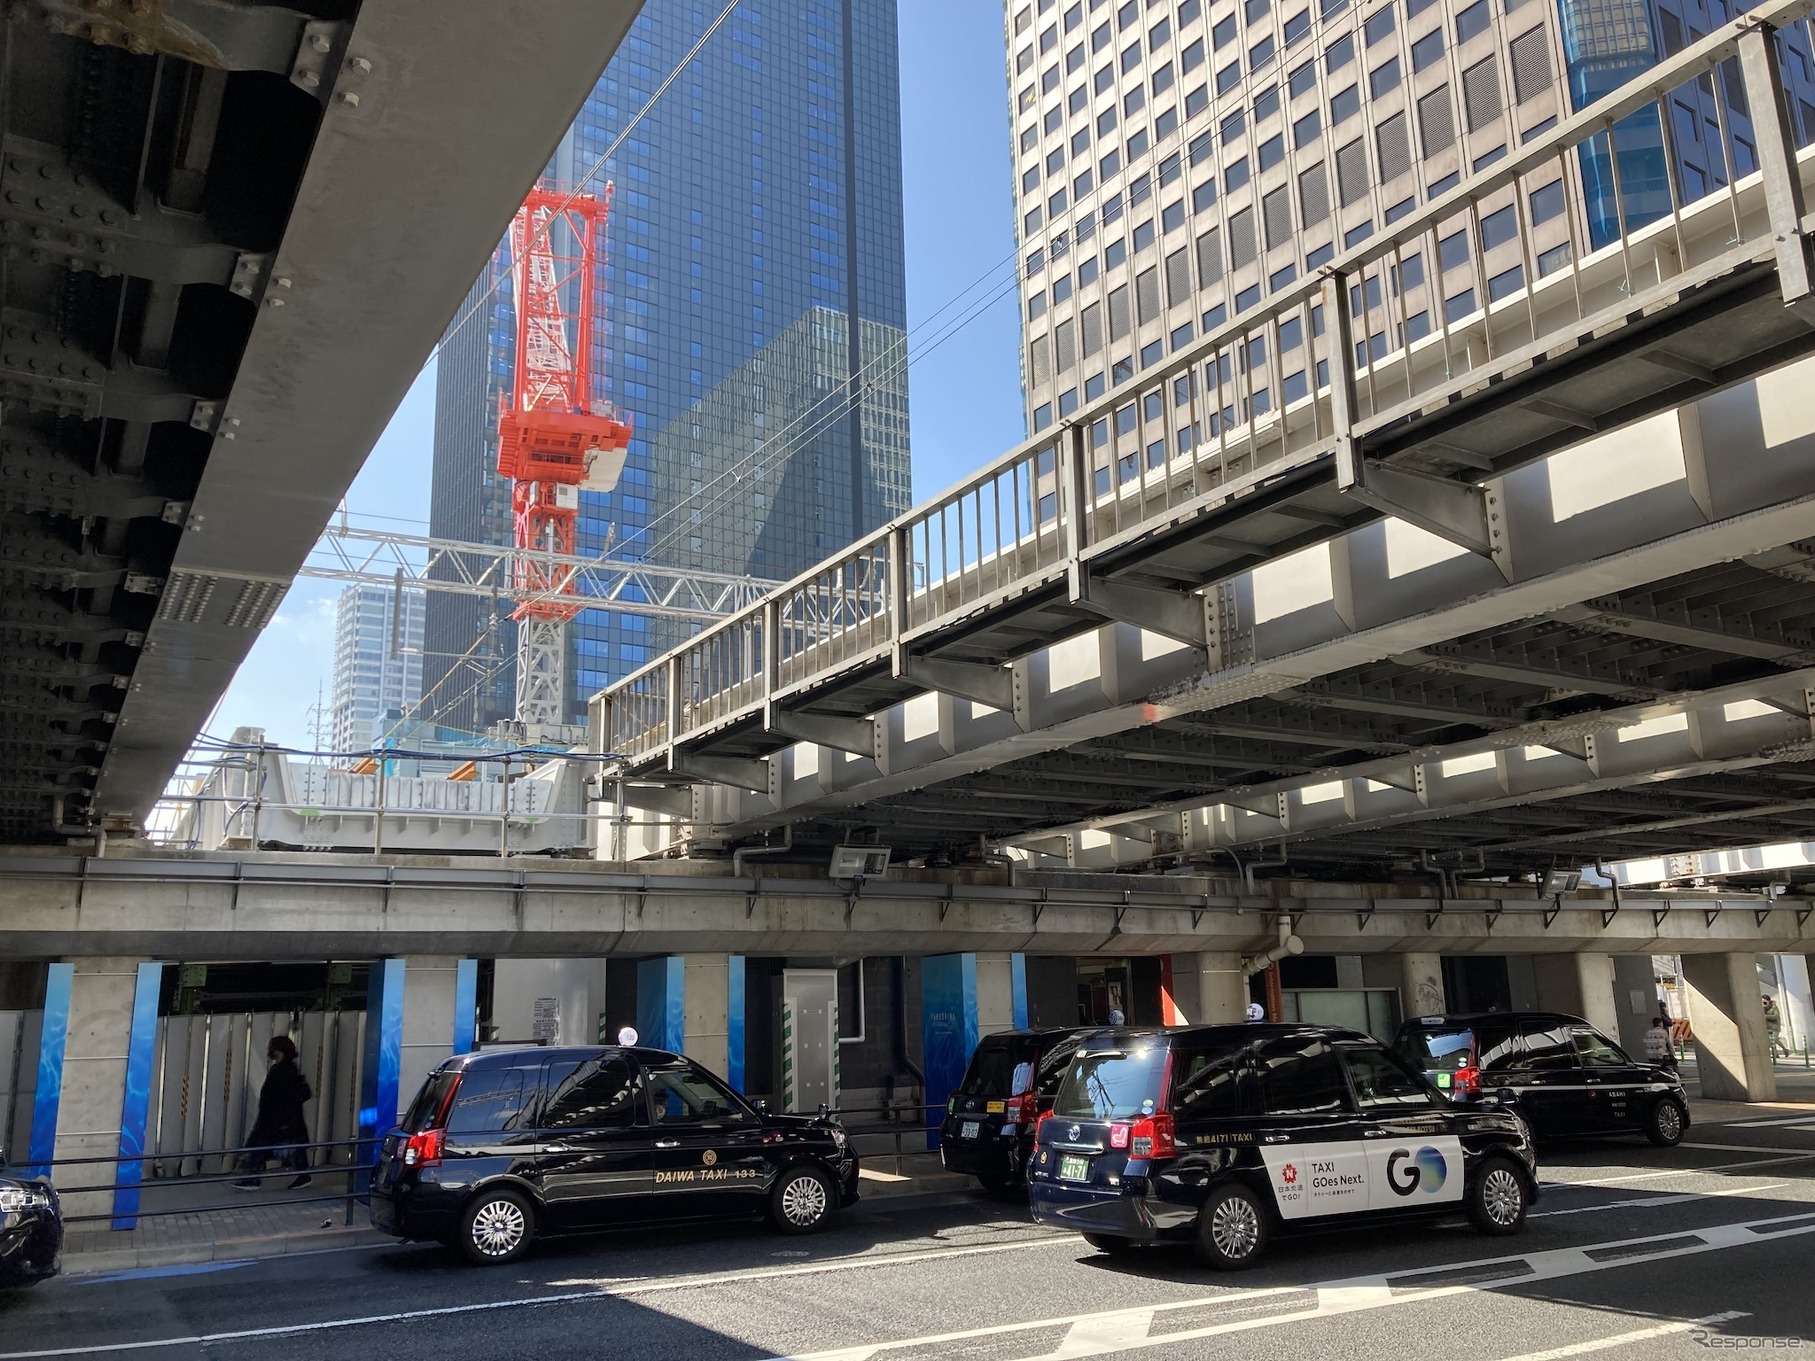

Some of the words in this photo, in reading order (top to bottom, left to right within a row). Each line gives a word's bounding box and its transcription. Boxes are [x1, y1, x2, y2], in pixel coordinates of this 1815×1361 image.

[1268, 971, 1276, 1011] Information
[1231, 1132, 1253, 1142] TAXI
[655, 1170, 695, 1183] DAIWA
[700, 1168, 728, 1181] TAXI
[734, 1169, 756, 1179] 133
[1311, 1162, 1335, 1174] TAXI
[1386, 1145, 1448, 1196] GO
[1312, 1176, 1339, 1188] GOes
[1340, 1173, 1365, 1186] Next.
[1278, 1184, 1304, 1193] 日本交通
